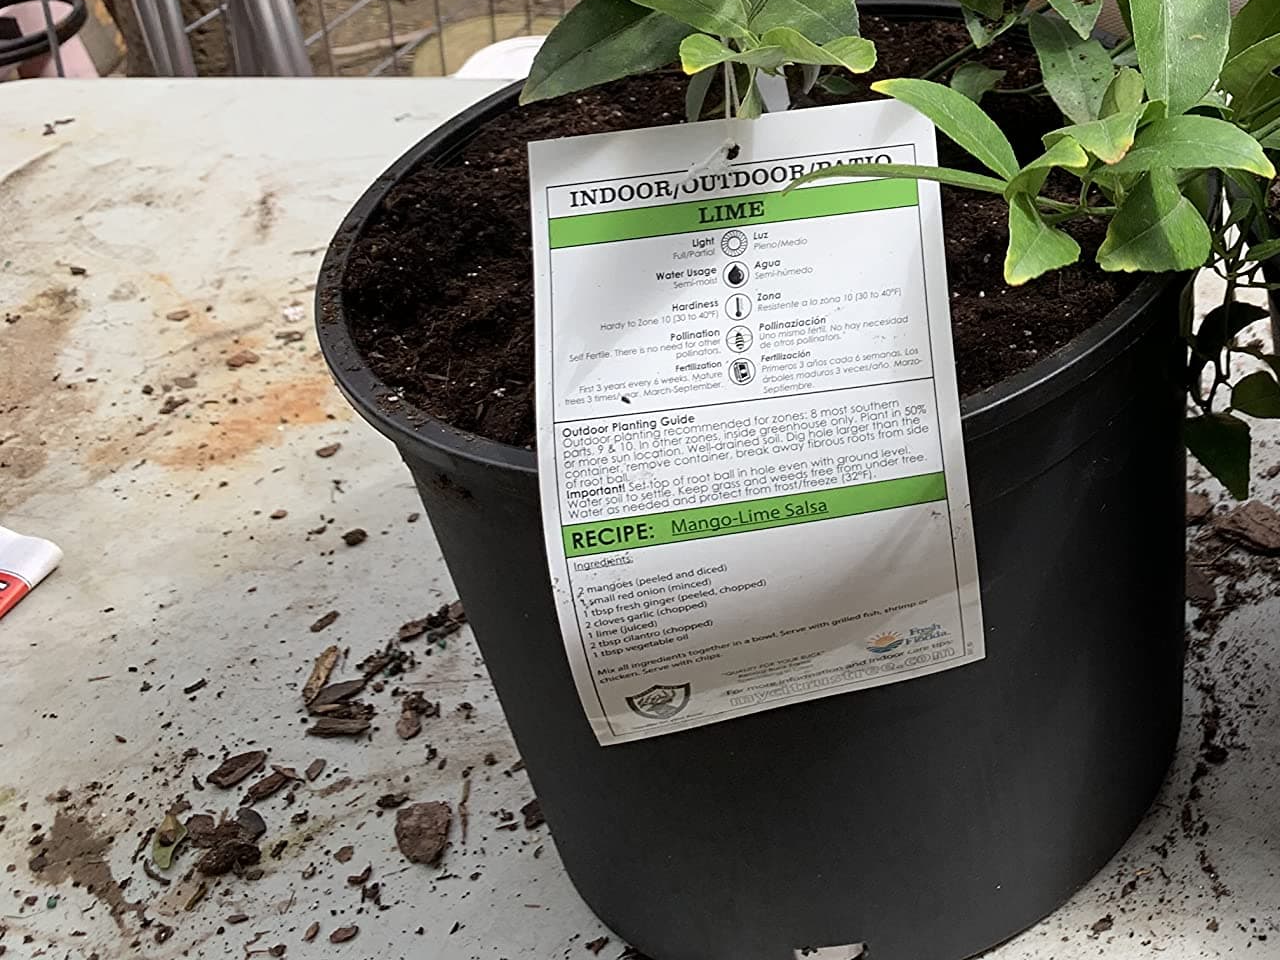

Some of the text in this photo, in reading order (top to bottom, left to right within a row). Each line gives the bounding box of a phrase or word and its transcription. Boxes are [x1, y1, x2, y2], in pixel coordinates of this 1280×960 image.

[699, 200, 765, 225] LIME
[692, 237, 714, 248] Light
[754, 232, 768, 240] Luz
[656, 268, 716, 280] Water Usage
[754, 260, 780, 270] Agua
[672, 301, 719, 312] Hardiness
[757, 293, 781, 301] Zona
[671, 329, 720, 341] Pollination
[676, 360, 722, 372] Fertilization
[562, 414, 695, 438] Outdoor Planting Guide
[563, 436, 610, 448] Outdoor
[615, 430, 660, 444] planting
[664, 418, 750, 436] recommended
[755, 416, 772, 425] for
[811, 409, 817, 418] 8
[821, 405, 847, 417] most
[850, 401, 899, 413] southern
[653, 438, 682, 448] other
[725, 428, 755, 440] inside
[760, 420, 826, 437] greenhouse
[861, 409, 888, 421] Plant
[905, 404, 927, 415] 50%
[579, 457, 608, 466] more
[612, 454, 630, 463] sun
[688, 437, 759, 454] Well-drained
[787, 432, 805, 442] Dig
[810, 428, 832, 438] hole
[837, 424, 869, 435] larger
[873, 420, 898, 430] than
[902, 416, 920, 426] the
[627, 425, 929, 471] remove break away fibrous roots from side
[566, 483, 625, 499] Important!
[687, 472, 710, 483] root
[714, 469, 734, 480] ball
[751, 465, 775, 475] hole
[779, 462, 808, 472] even
[811, 456, 833, 467] with
[837, 450, 878, 466] ground
[567, 498, 602, 509] Water
[606, 494, 623, 504] soil
[679, 485, 708, 495] Keep
[712, 481, 740, 493] grass
[744, 476, 767, 487] and
[771, 470, 808, 482] weeds
[811, 468, 833, 477] free
[837, 464, 862, 473] from
[866, 458, 898, 469] under
[902, 455, 927, 464] tree.
[580, 476, 603, 487] root
[568, 508, 603, 519] Water
[623, 498, 669, 512] needed
[673, 495, 696, 506] and
[700, 489, 741, 505] protect
[745, 487, 771, 497] from
[774, 477, 837, 492] frost/freeze
[572, 500, 828, 549] RECIPE: Mango-Lime Salsa
[587, 563, 727, 593] mangoes (peeled and diced)
[589, 577, 711, 605] small red onion (minced)
[591, 577, 766, 616] tbsp fresh ginger (peeled, chopped)
[594, 599, 707, 627] cloves garlic (chopped)
[596, 619, 658, 638] lime (juiced)
[599, 618, 713, 648] tbsp cilantro (chopped)
[597, 667, 614, 675] Mix
[617, 663, 629, 672] all
[632, 652, 686, 669] ingredients
[689, 642, 730, 656] together
[780, 626, 806, 635] Serve
[810, 620, 830, 629] with
[833, 613, 861, 627] grilled
[601, 632, 688, 656] tbsp vegetable oil
[643, 657, 693, 675] Serve with
